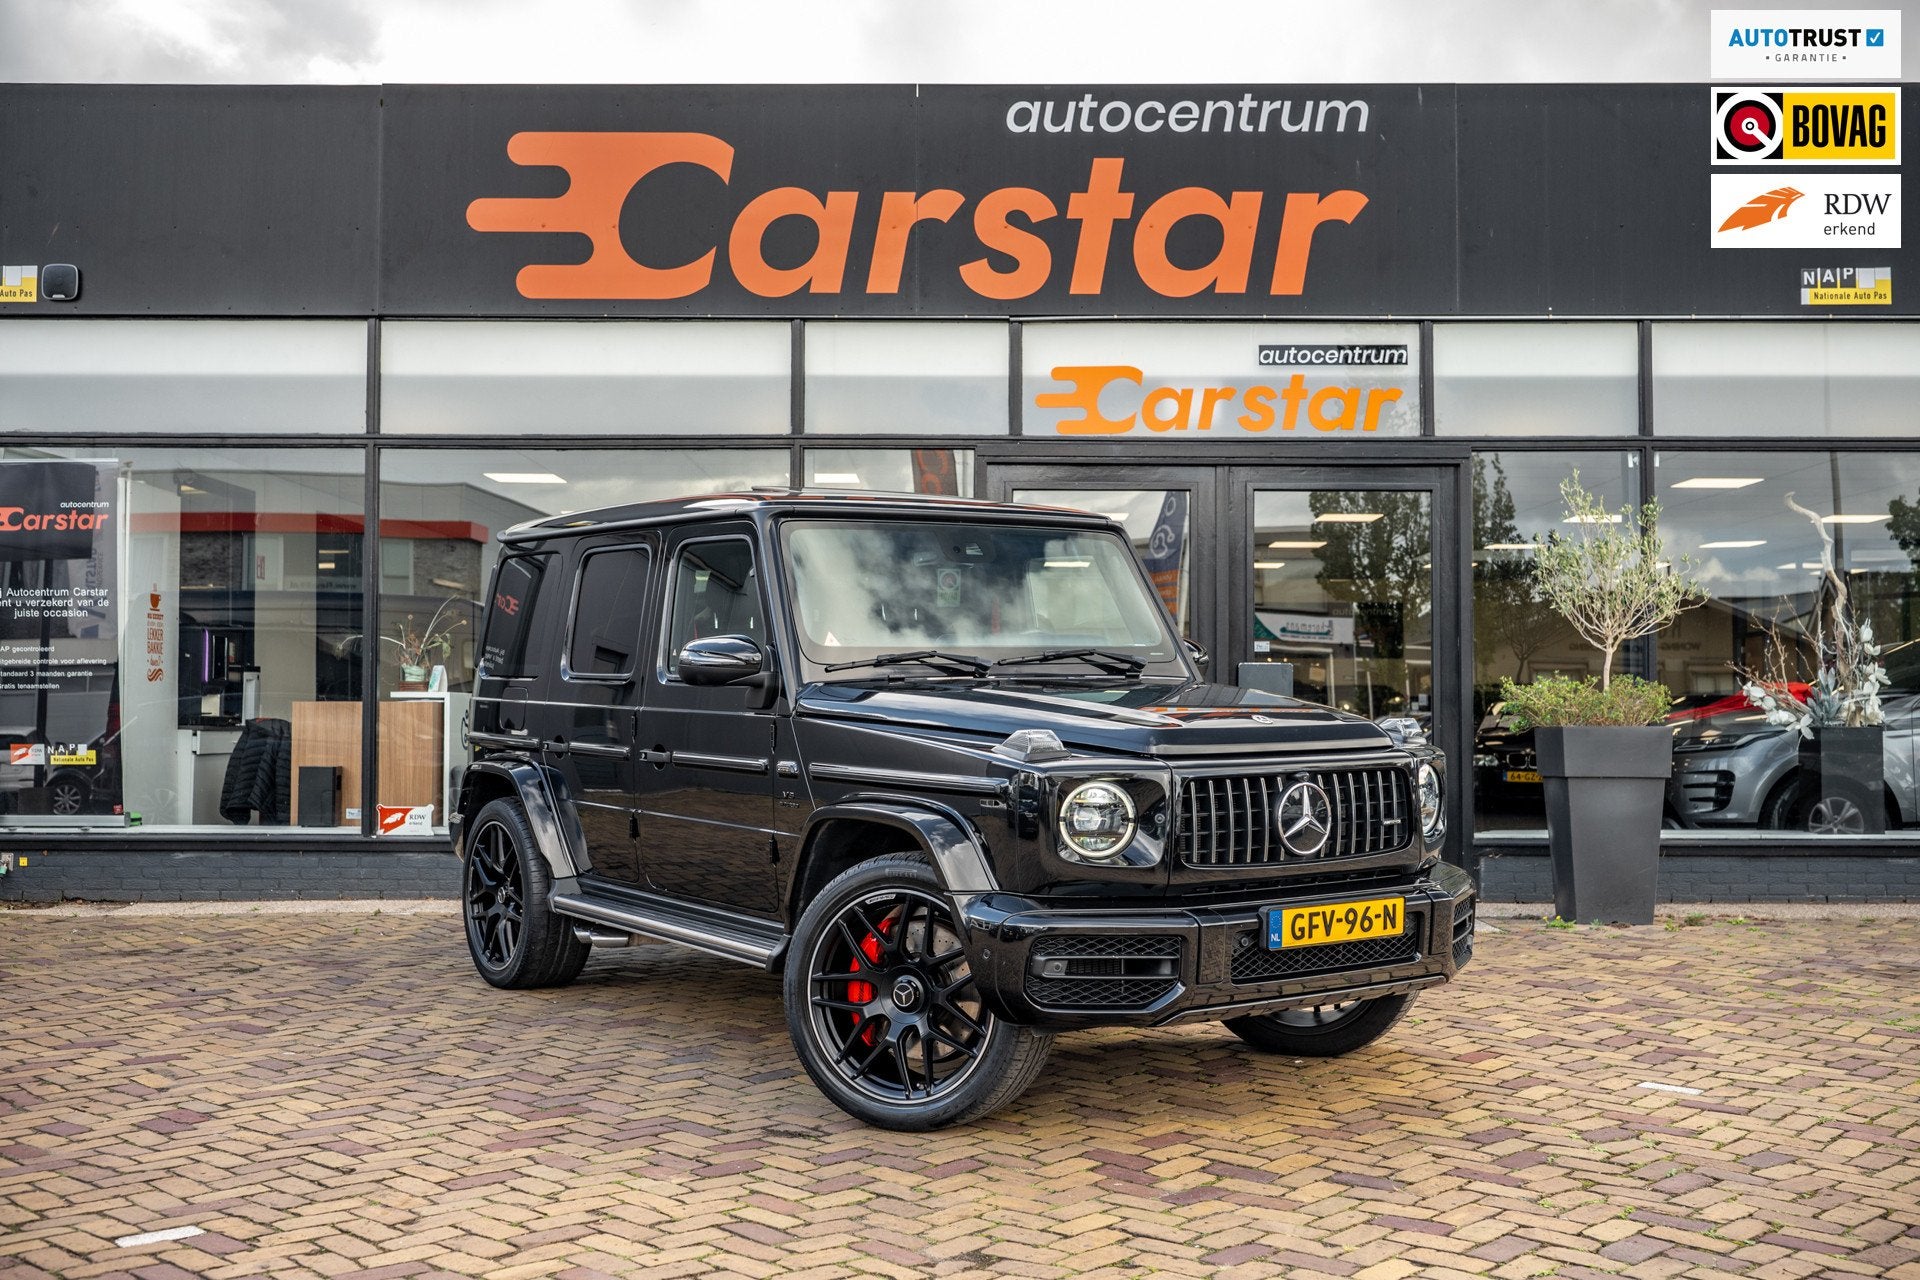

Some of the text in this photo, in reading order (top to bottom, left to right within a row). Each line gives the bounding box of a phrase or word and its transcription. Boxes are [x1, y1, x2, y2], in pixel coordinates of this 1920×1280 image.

[1006, 93, 1369, 133] autocentrum
[466, 131, 1369, 300] Carstar
[0, 289, 33, 297] Auto Pas
[1814, 291, 1888, 300] Nationale Auto Pas
[1259, 345, 1407, 365] autocentrum
[1035, 365, 1404, 434] Carstar
[0, 507, 109, 531] Carstar
[6, 587, 69, 597] Autocentrum
[73, 587, 109, 597] Carstar
[25, 598, 73, 607] verzekerd
[97, 598, 109, 607] de
[14, 608, 88, 619] juiste occasion
[66, 670, 93, 678] garantie
[1290, 903, 1397, 941] GFV-96-N
[1270, 933, 1281, 942] NL
